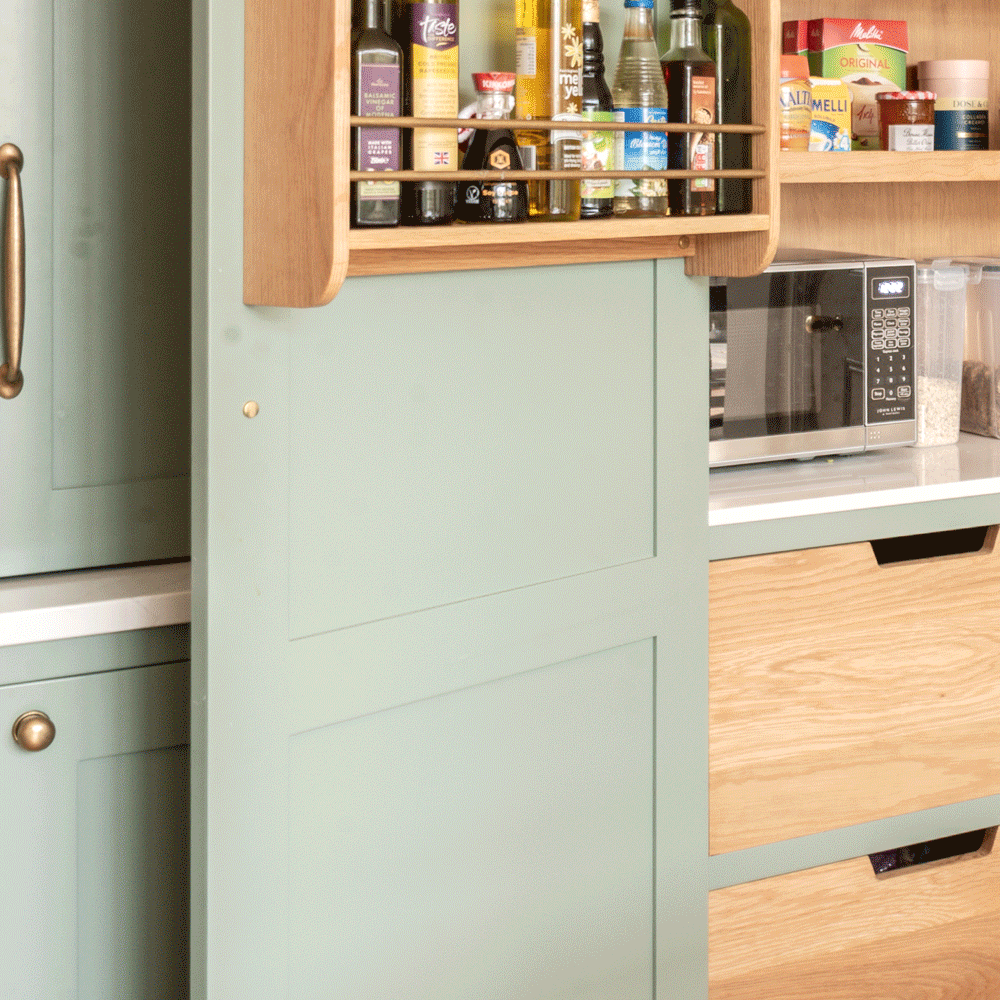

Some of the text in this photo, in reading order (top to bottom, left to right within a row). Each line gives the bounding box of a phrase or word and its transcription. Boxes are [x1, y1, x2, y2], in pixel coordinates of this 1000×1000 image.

[418, 15, 457, 44] taste
[848, 22, 885, 41] Melitta
[839, 57, 891, 70] ORIGINAL
[363, 92, 397, 100] BALSAMIC
